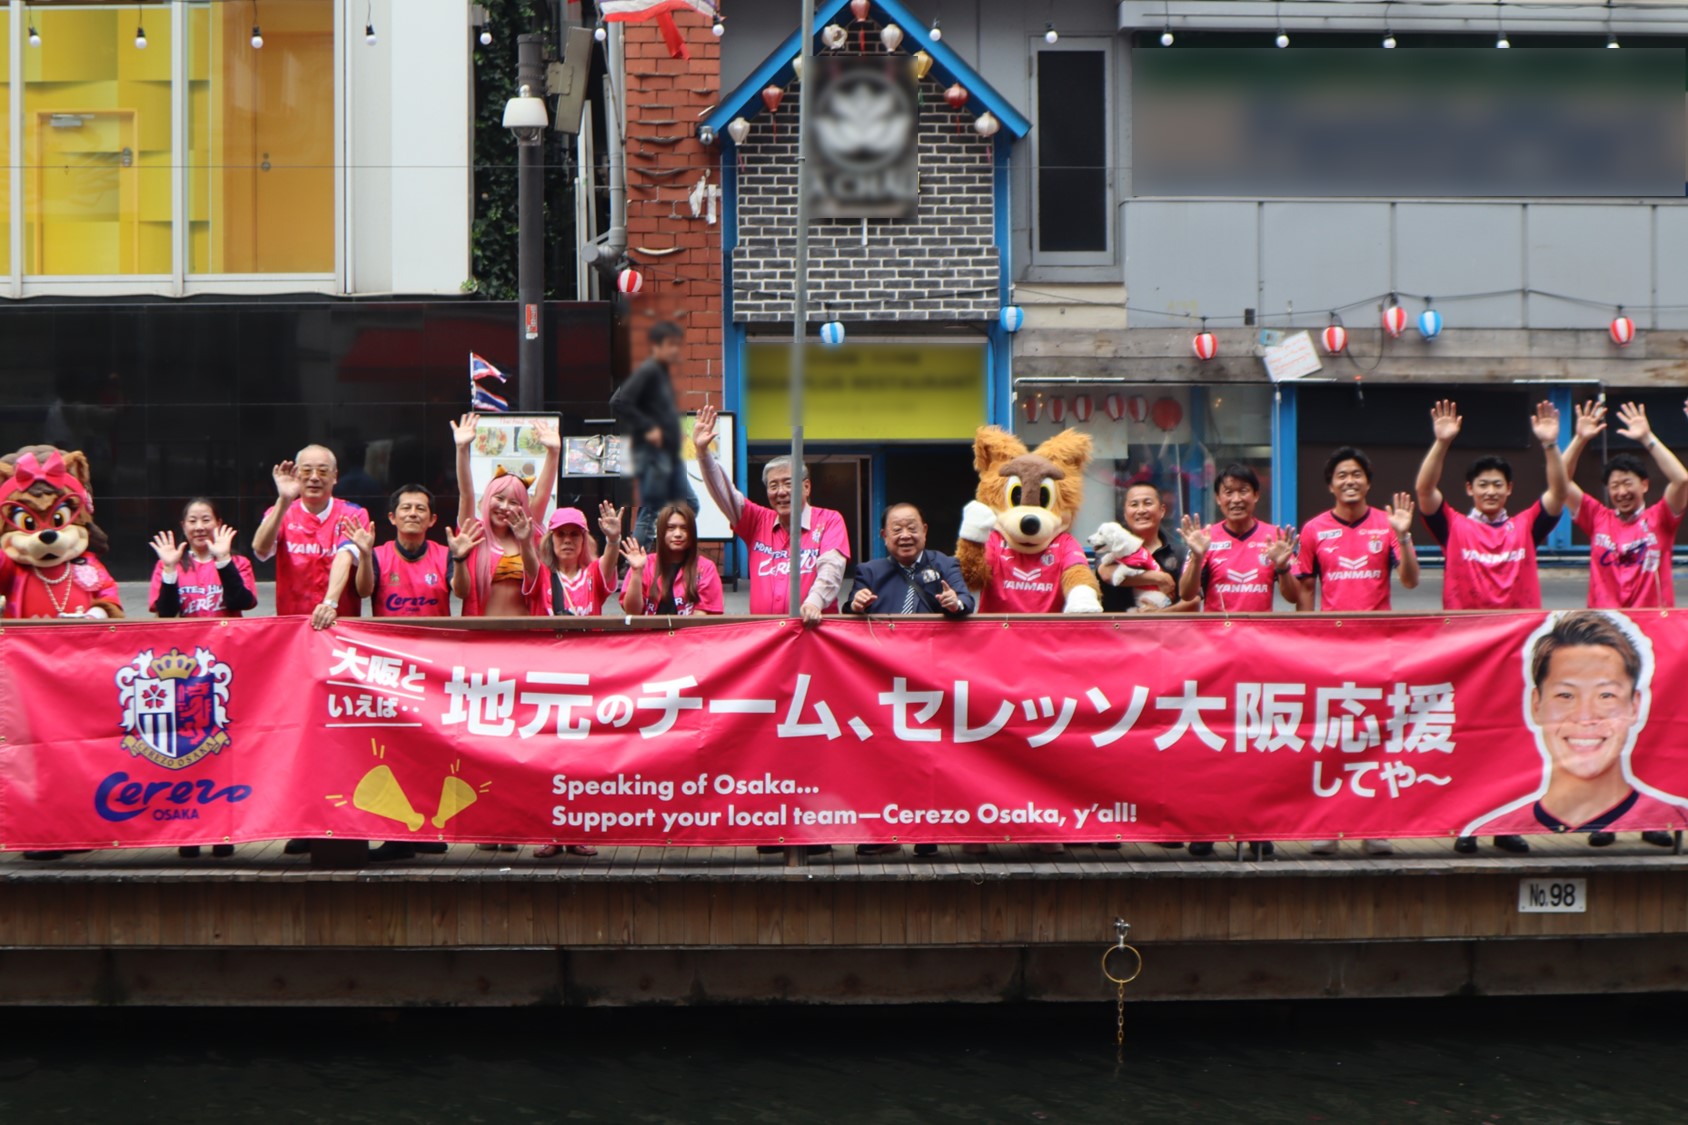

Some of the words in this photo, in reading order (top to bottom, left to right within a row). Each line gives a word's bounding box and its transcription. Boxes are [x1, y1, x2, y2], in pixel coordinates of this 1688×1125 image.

[1215, 583, 1268, 593] YANMAR
[1328, 570, 1381, 581] YANMAR
[329, 646, 426, 693] 大阪と
[137, 741, 175, 767] CEREZO
[177, 741, 214, 767] OSAKA
[95, 771, 253, 822] Cerezo
[552, 773, 674, 801] Speaking
[681, 773, 707, 795] of
[713, 773, 819, 795] Osaka...
[153, 809, 200, 821] OSAKA
[552, 805, 655, 832] Support
[663, 811, 721, 832] your
[728, 804, 787, 826] local
[977, 802, 1066, 827] Osaka,
